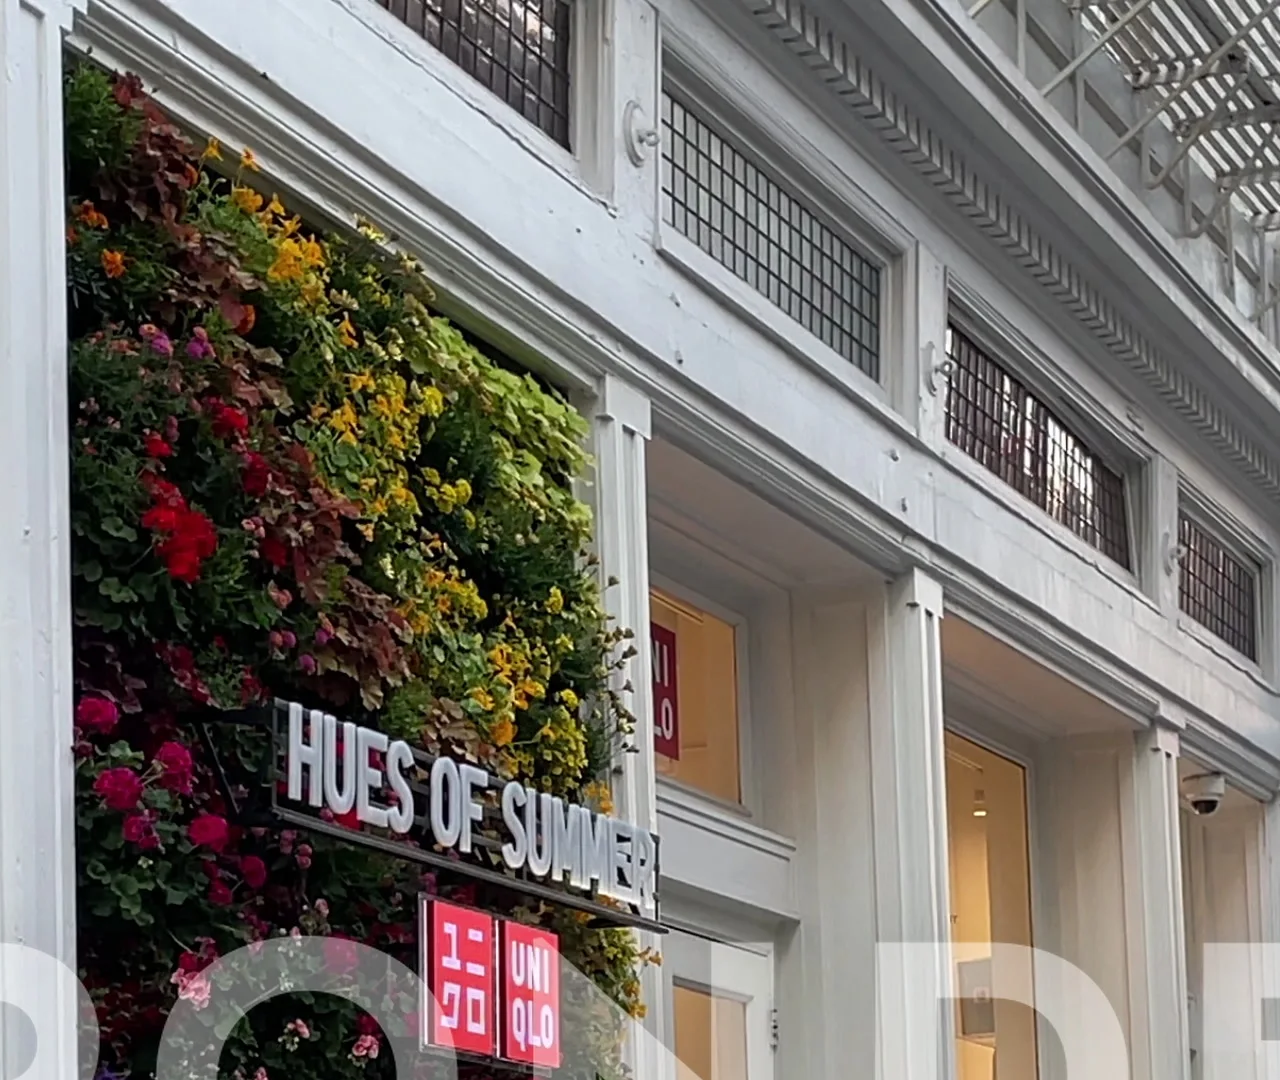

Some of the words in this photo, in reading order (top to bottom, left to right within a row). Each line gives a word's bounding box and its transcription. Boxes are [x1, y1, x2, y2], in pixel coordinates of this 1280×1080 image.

[287, 702, 415, 833] HUES
[430, 756, 489, 853] OF
[501, 781, 656, 909] SUMMER
[511, 939, 550, 994] UNI
[511, 998, 554, 1052] QLO
